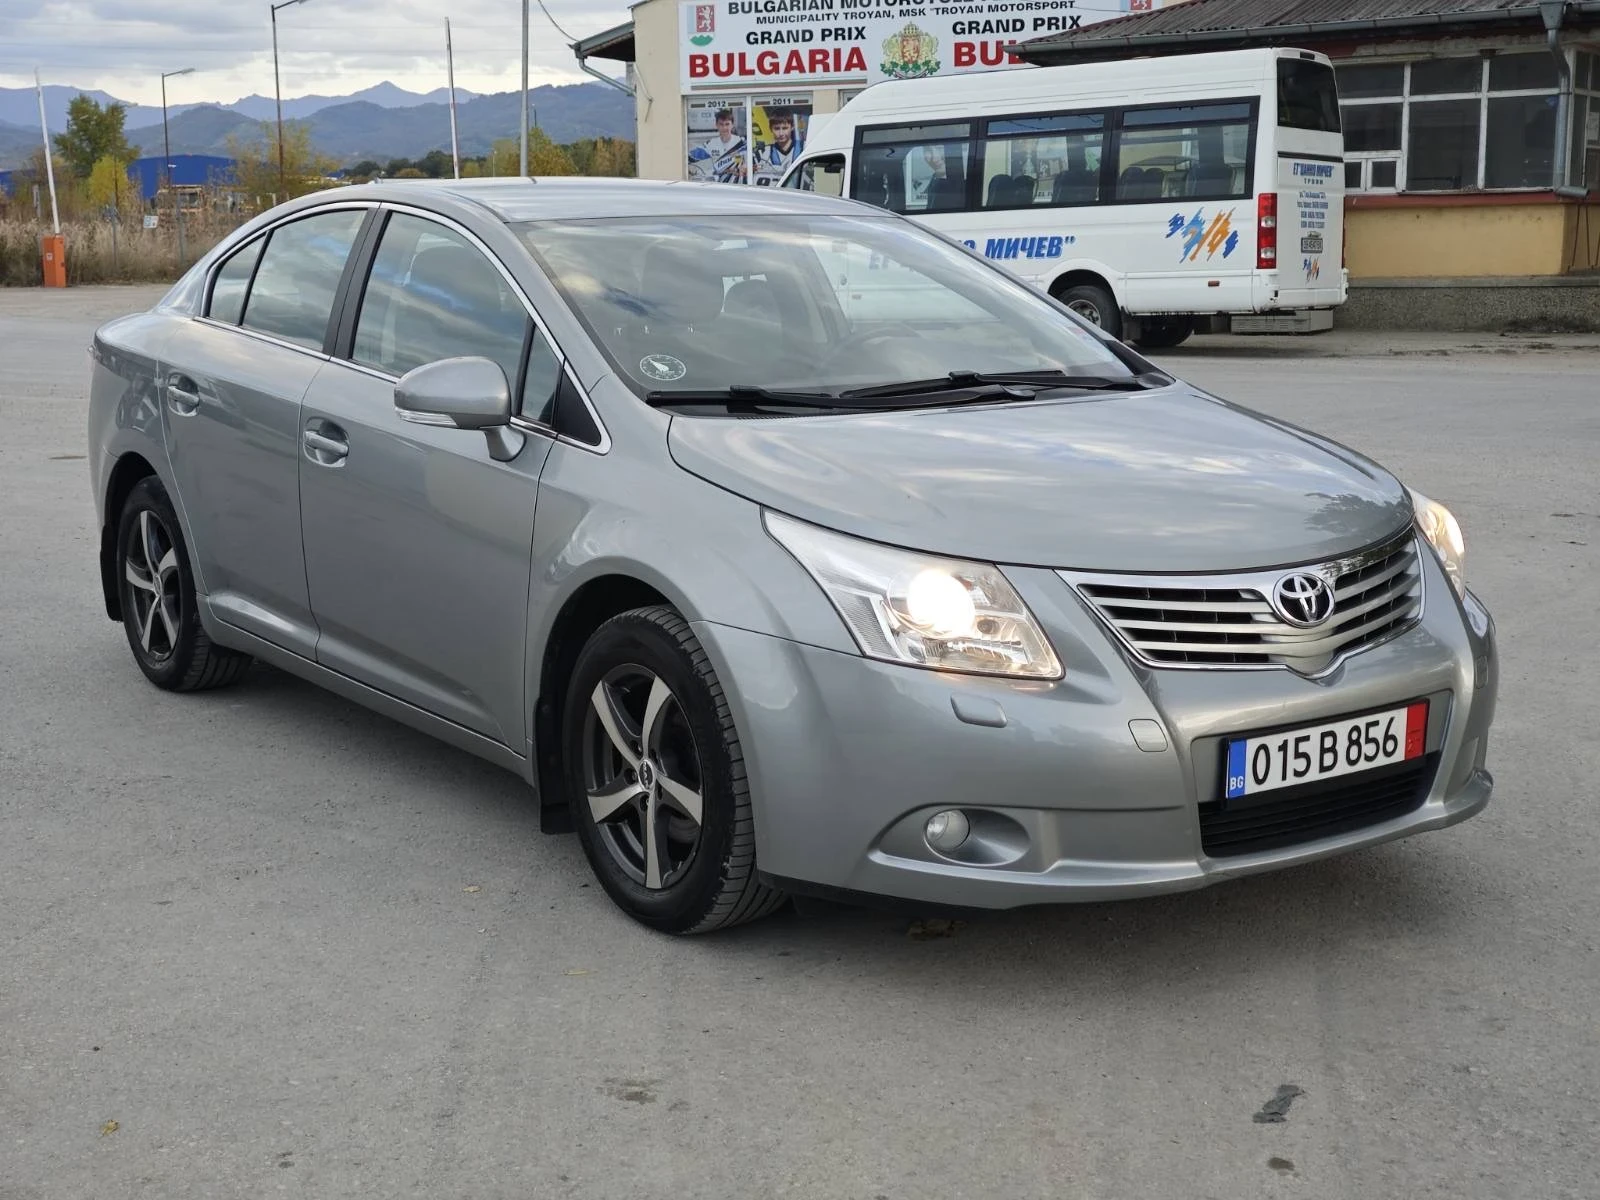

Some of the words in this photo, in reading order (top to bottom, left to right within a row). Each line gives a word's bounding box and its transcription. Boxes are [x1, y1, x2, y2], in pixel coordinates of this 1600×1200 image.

[727, 0, 834, 15] BULGARIAN
[756, 13, 839, 25] MUNICIPALITY
[844, 10, 895, 21] TROYAN,
[899, 8, 926, 17] MSK
[987, 1, 1076, 14] MOTORSPORT
[952, 18, 1025, 35] GRAND
[1033, 15, 1082, 31] PRIX
[746, 28, 814, 45] GRAND
[821, 26, 867, 42] PRIX
[689, 46, 868, 78] BULGARIA
[985, 236, 1076, 259] МИЧЕВ"
[1229, 775, 1245, 791] BG
